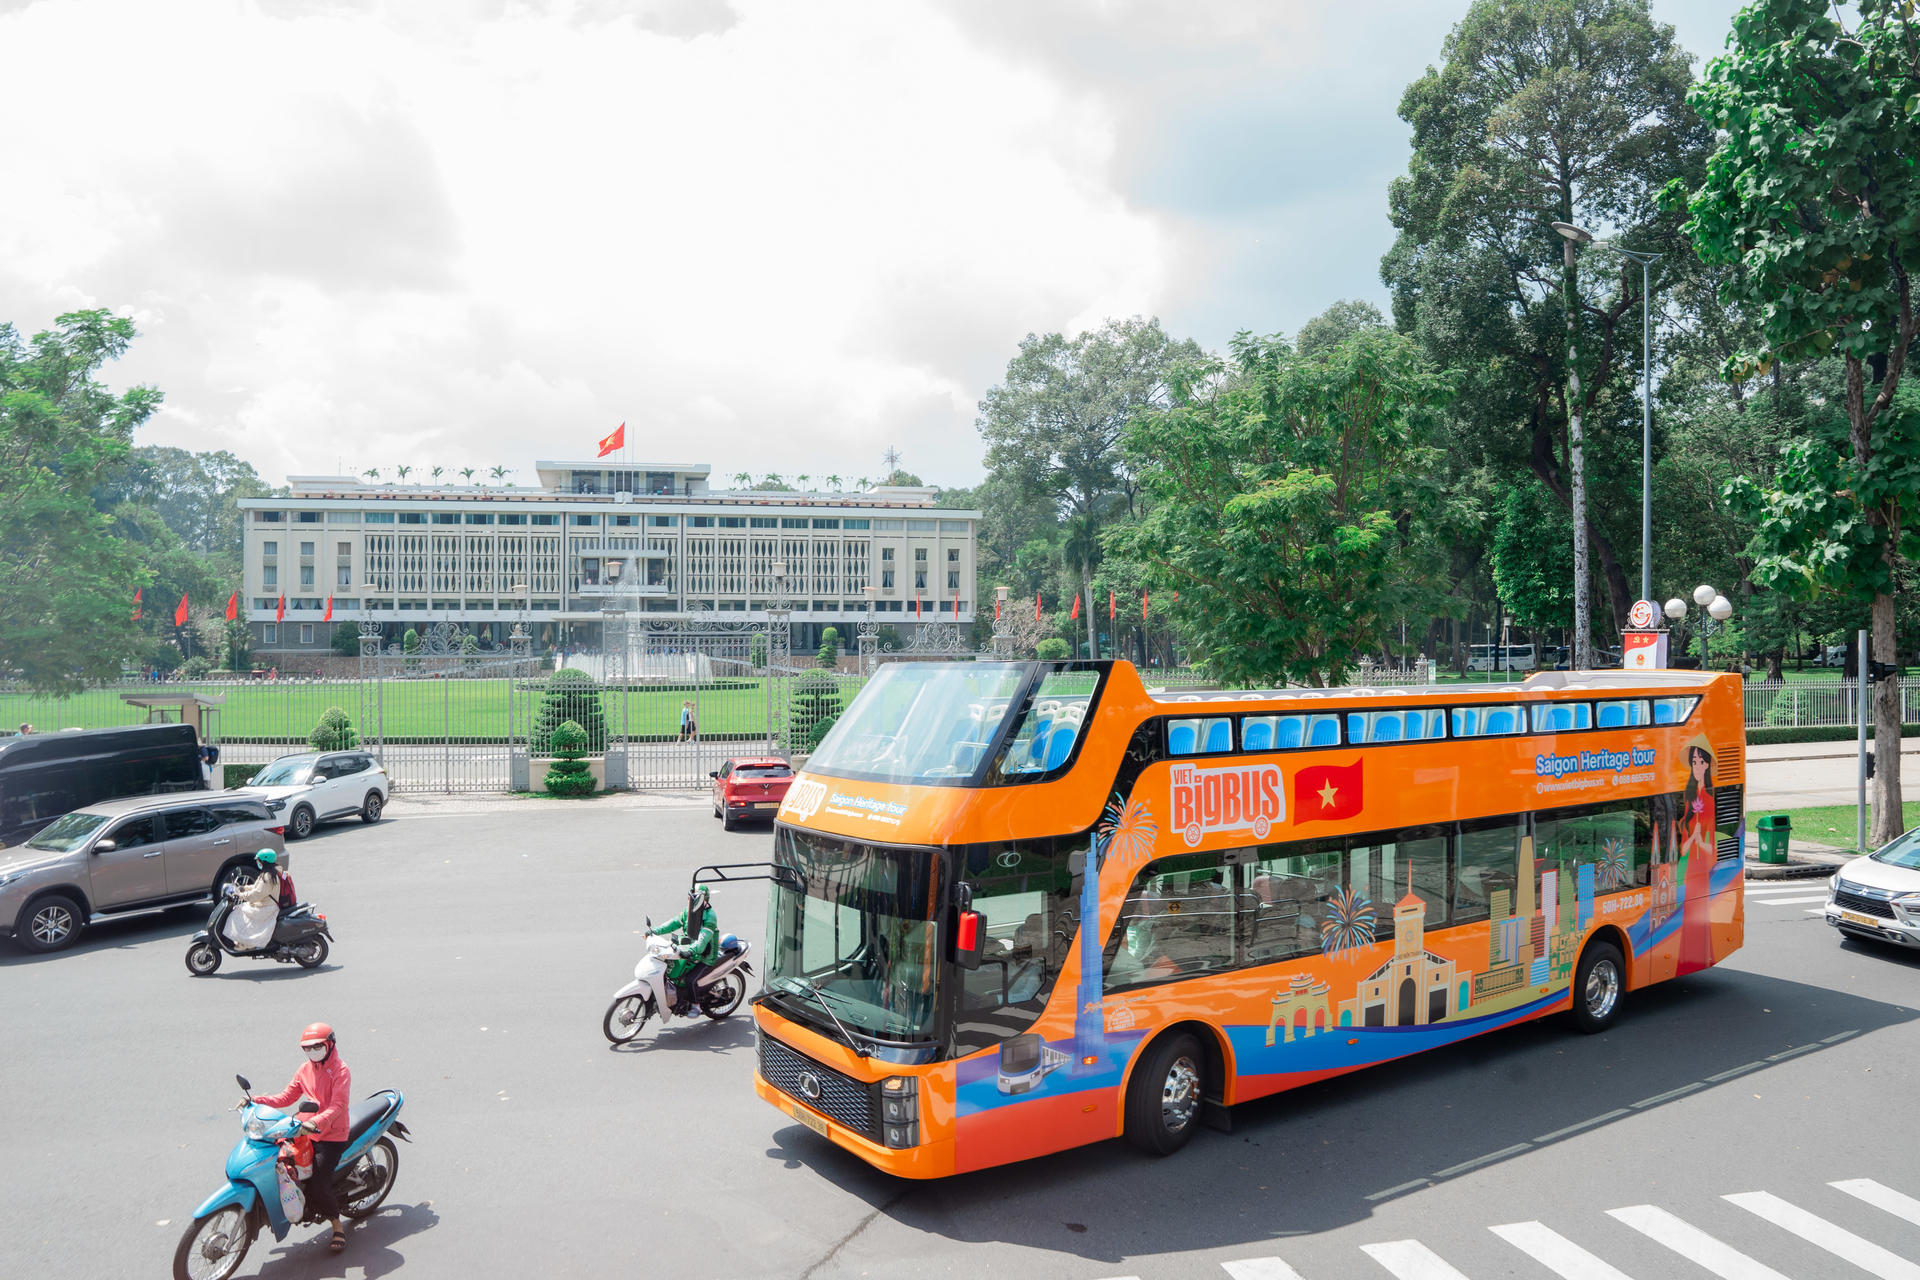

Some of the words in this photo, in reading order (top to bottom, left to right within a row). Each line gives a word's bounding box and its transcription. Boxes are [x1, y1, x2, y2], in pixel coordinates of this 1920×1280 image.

[1536, 755, 1578, 778] Saigon
[1580, 749, 1630, 771] Heritage
[1632, 747, 1655, 766] tour
[1173, 768, 1193, 785] VIET
[829, 792, 854, 807] Saigon
[854, 796, 887, 812] Heritage
[886, 801, 908, 816] tour
